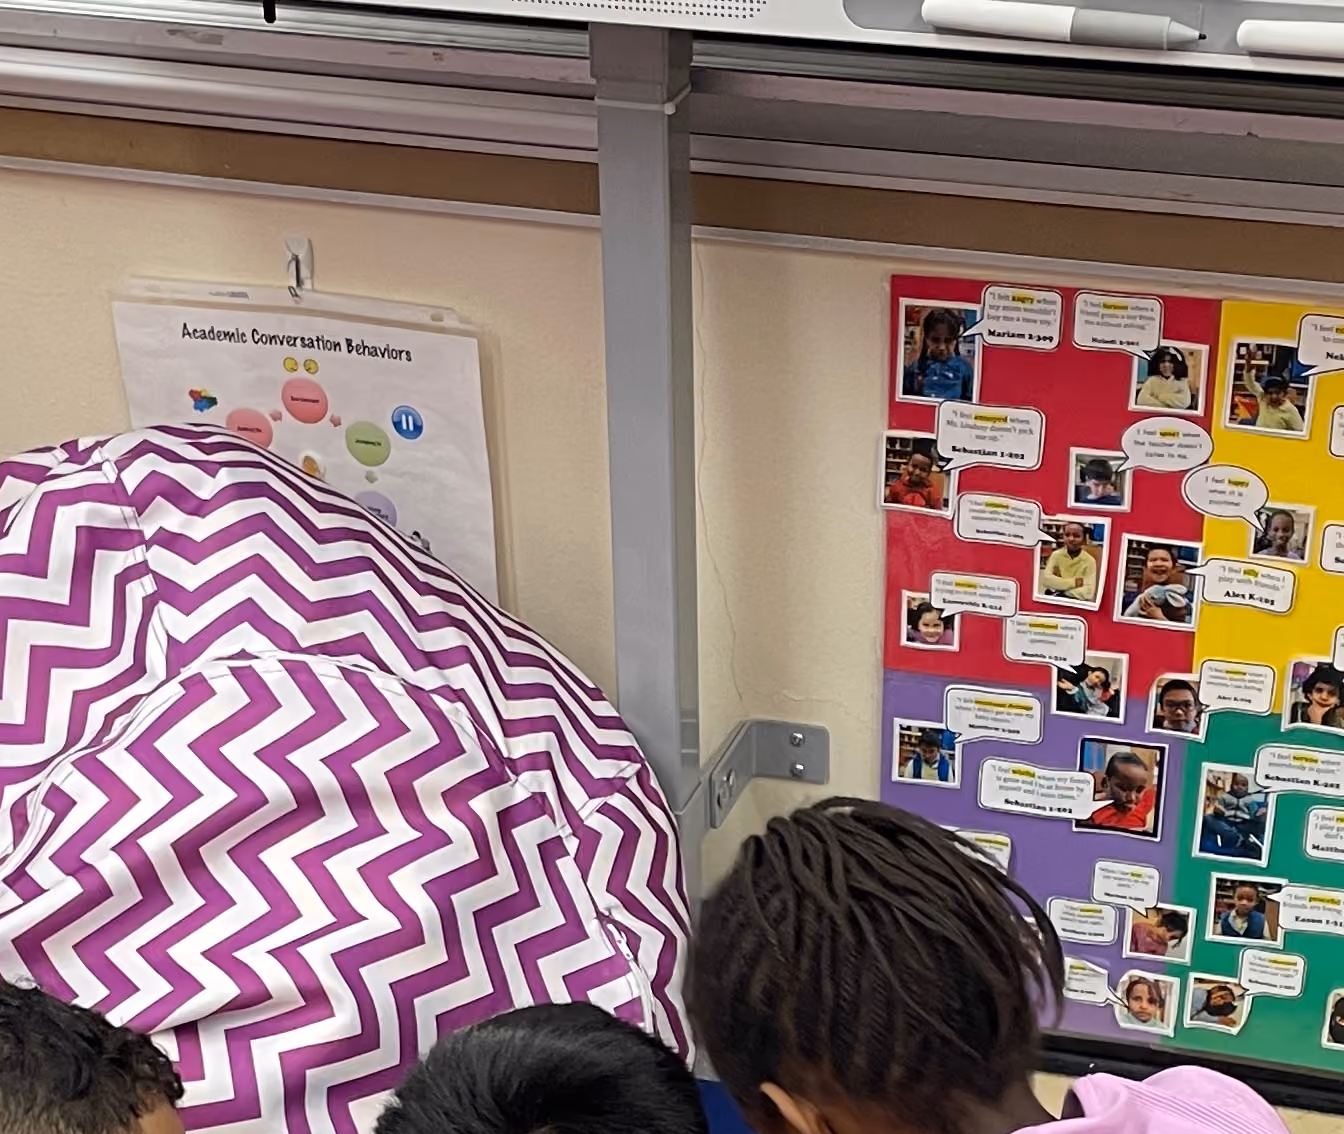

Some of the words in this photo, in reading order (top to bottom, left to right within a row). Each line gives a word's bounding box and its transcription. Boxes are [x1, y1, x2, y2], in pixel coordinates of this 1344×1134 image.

[181, 321, 248, 345] Academic
[251, 328, 343, 353] Conversation
[346, 336, 412, 363] Behaviors
